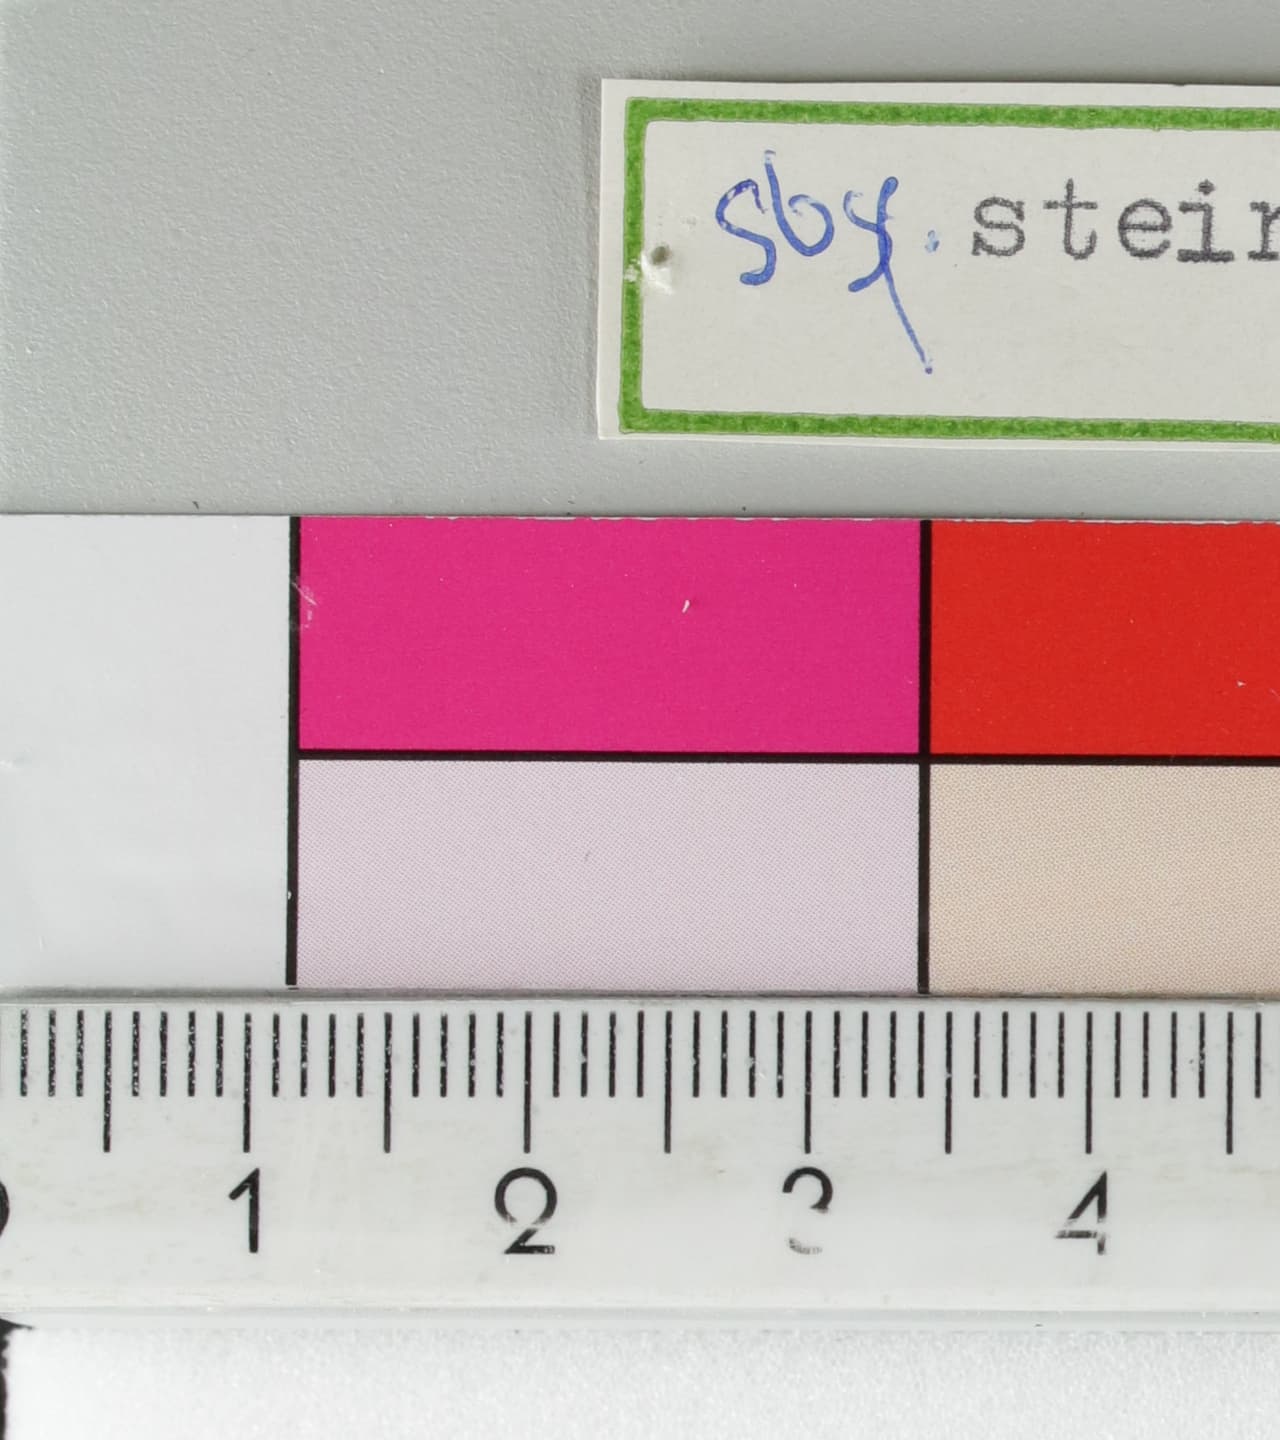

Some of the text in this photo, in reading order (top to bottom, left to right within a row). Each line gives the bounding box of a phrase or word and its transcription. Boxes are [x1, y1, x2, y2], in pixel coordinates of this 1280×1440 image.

[228, 1167, 261, 1254] 1
[494, 1166, 558, 1255] 2
[1054, 1168, 1108, 1256] 4
